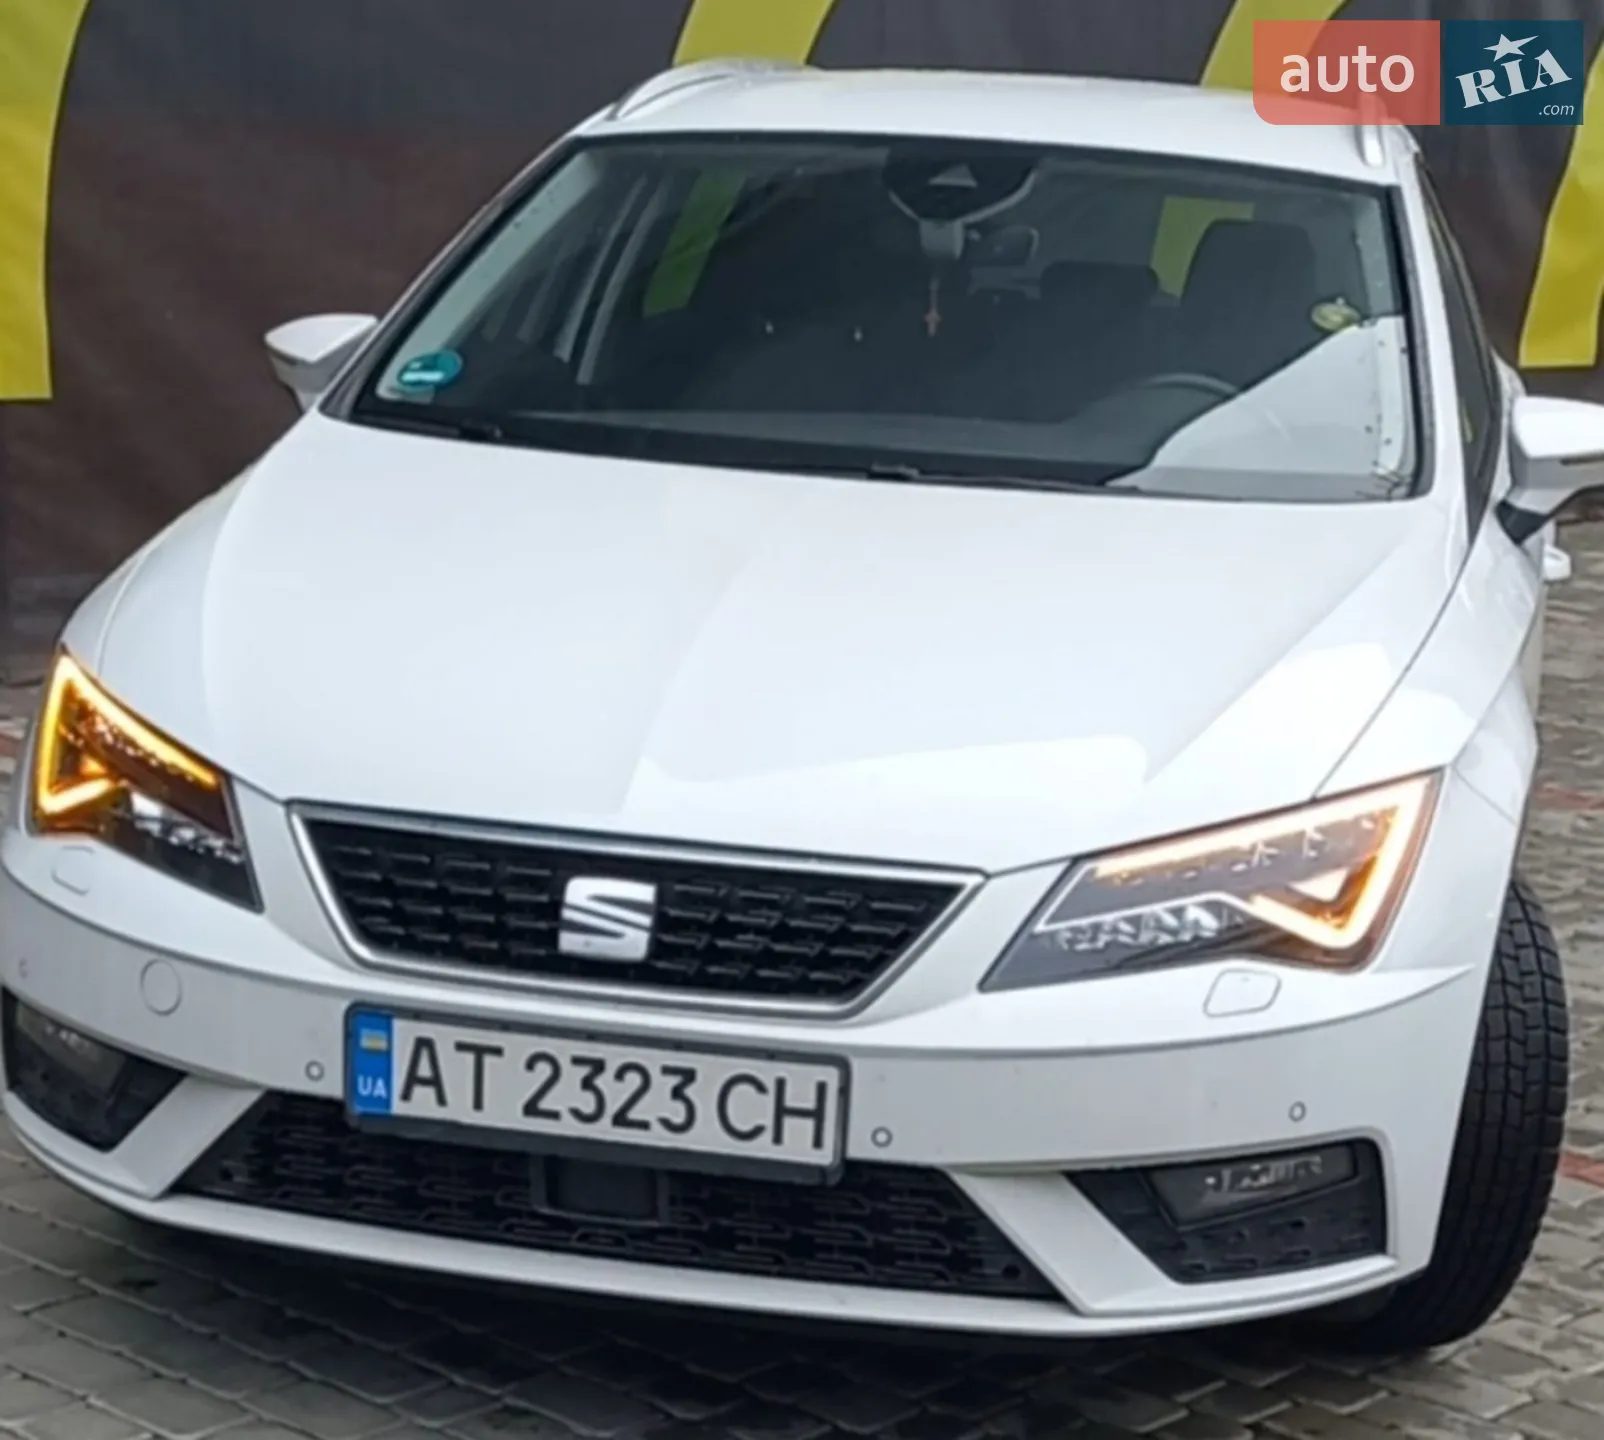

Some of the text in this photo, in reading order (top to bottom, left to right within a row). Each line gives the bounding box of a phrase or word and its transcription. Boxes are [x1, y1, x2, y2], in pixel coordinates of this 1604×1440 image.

[357, 1074, 387, 1098] UA
[400, 1036, 828, 1150] AT 2323 CH
